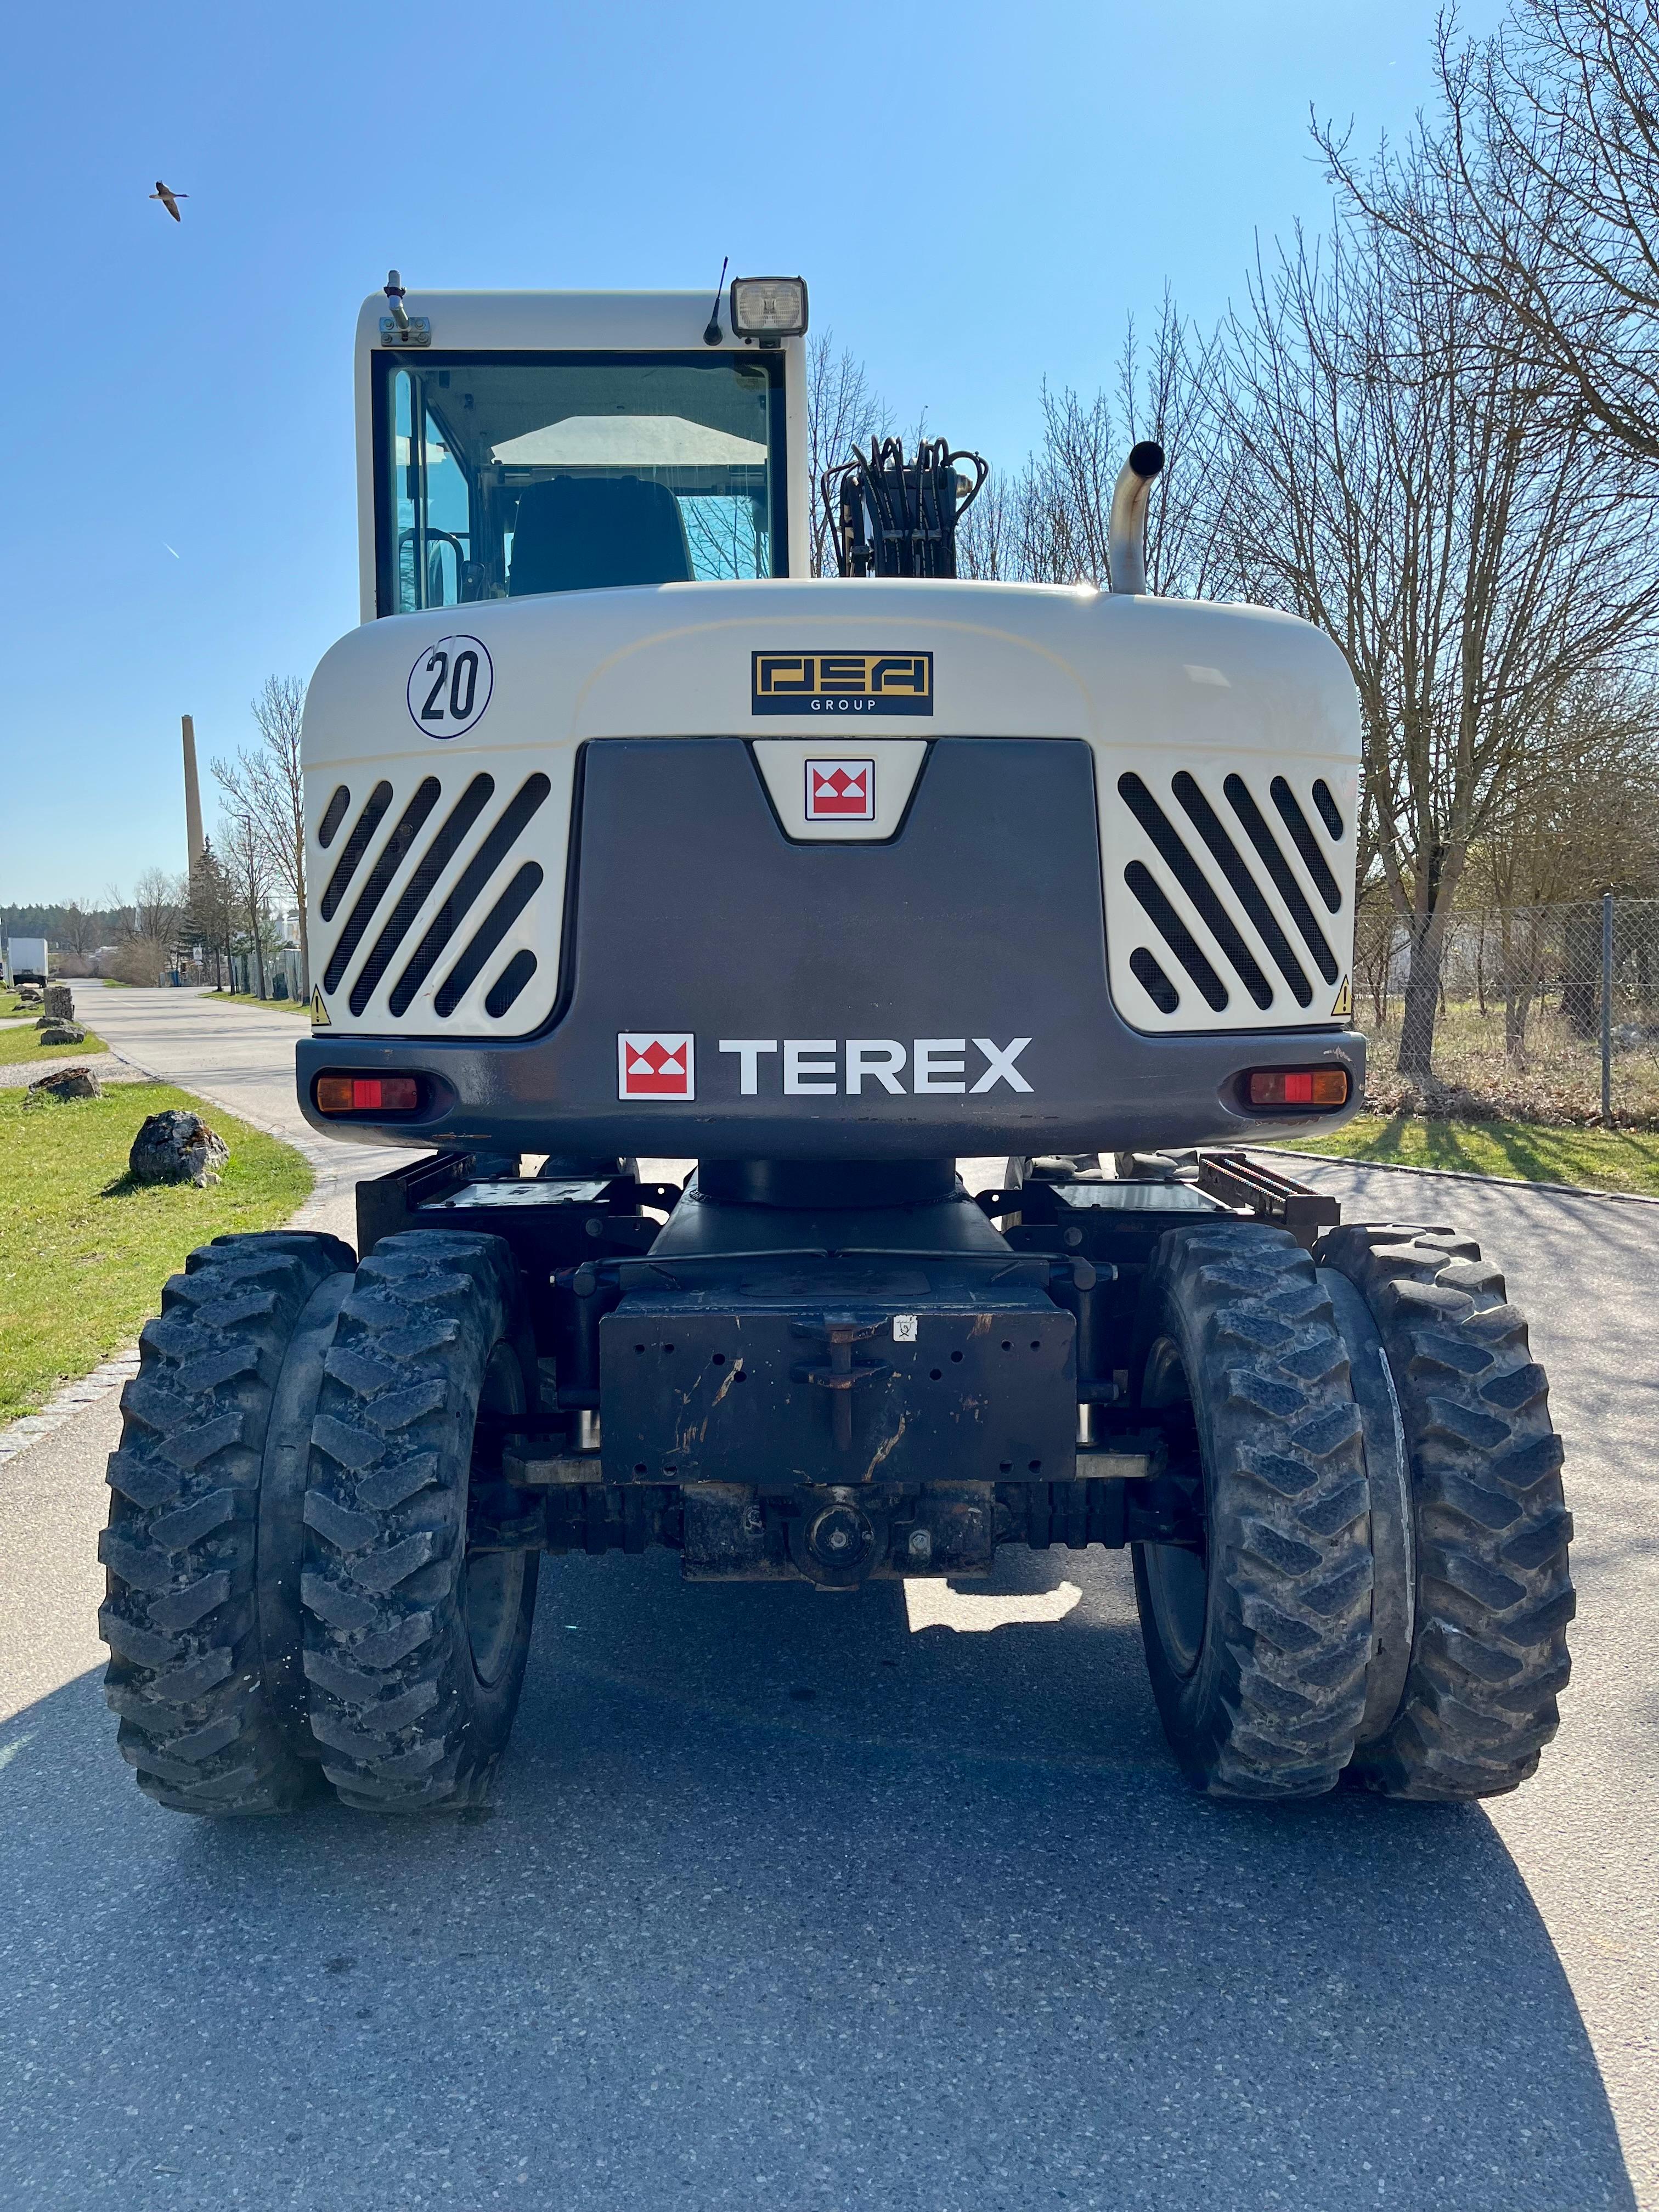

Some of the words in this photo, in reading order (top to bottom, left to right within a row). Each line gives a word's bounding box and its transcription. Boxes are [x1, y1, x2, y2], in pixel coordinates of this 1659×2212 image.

[421, 650, 478, 720] 20
[810, 699, 876, 710] GROUP
[719, 1037, 1034, 1095] TEREX
